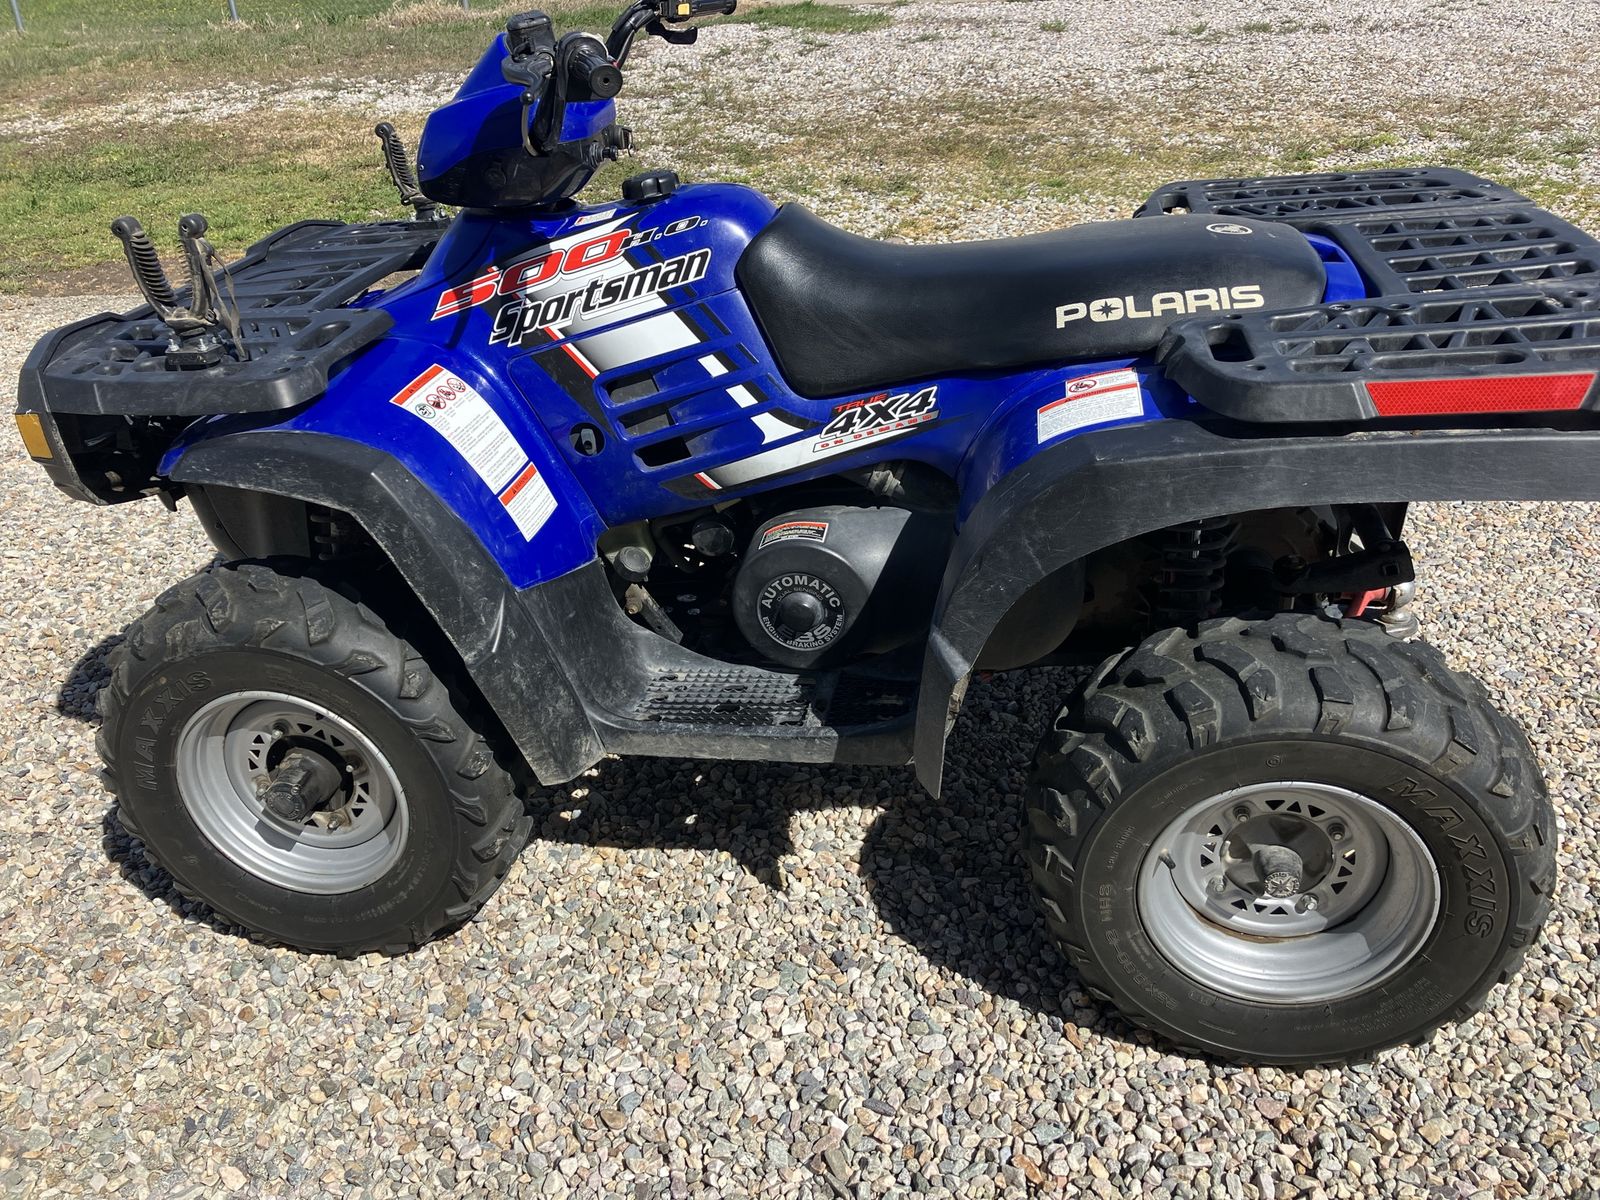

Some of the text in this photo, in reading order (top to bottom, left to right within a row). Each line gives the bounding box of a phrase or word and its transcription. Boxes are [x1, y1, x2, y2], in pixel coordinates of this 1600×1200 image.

[431, 228, 632, 321] 500
[489, 248, 712, 347] Sportsman
[1055, 285, 1265, 329] POLARIS
[819, 385, 938, 440] 4X4
[834, 393, 889, 413] TRUE
[761, 575, 841, 609] AUTOMATIC
[793, 587, 824, 601] SENSING
[786, 638, 825, 648] BRAKING
[824, 614, 844, 642] SYSTEM
[134, 671, 213, 792] MAXXIS
[1386, 776, 1497, 939] MAXXIS
